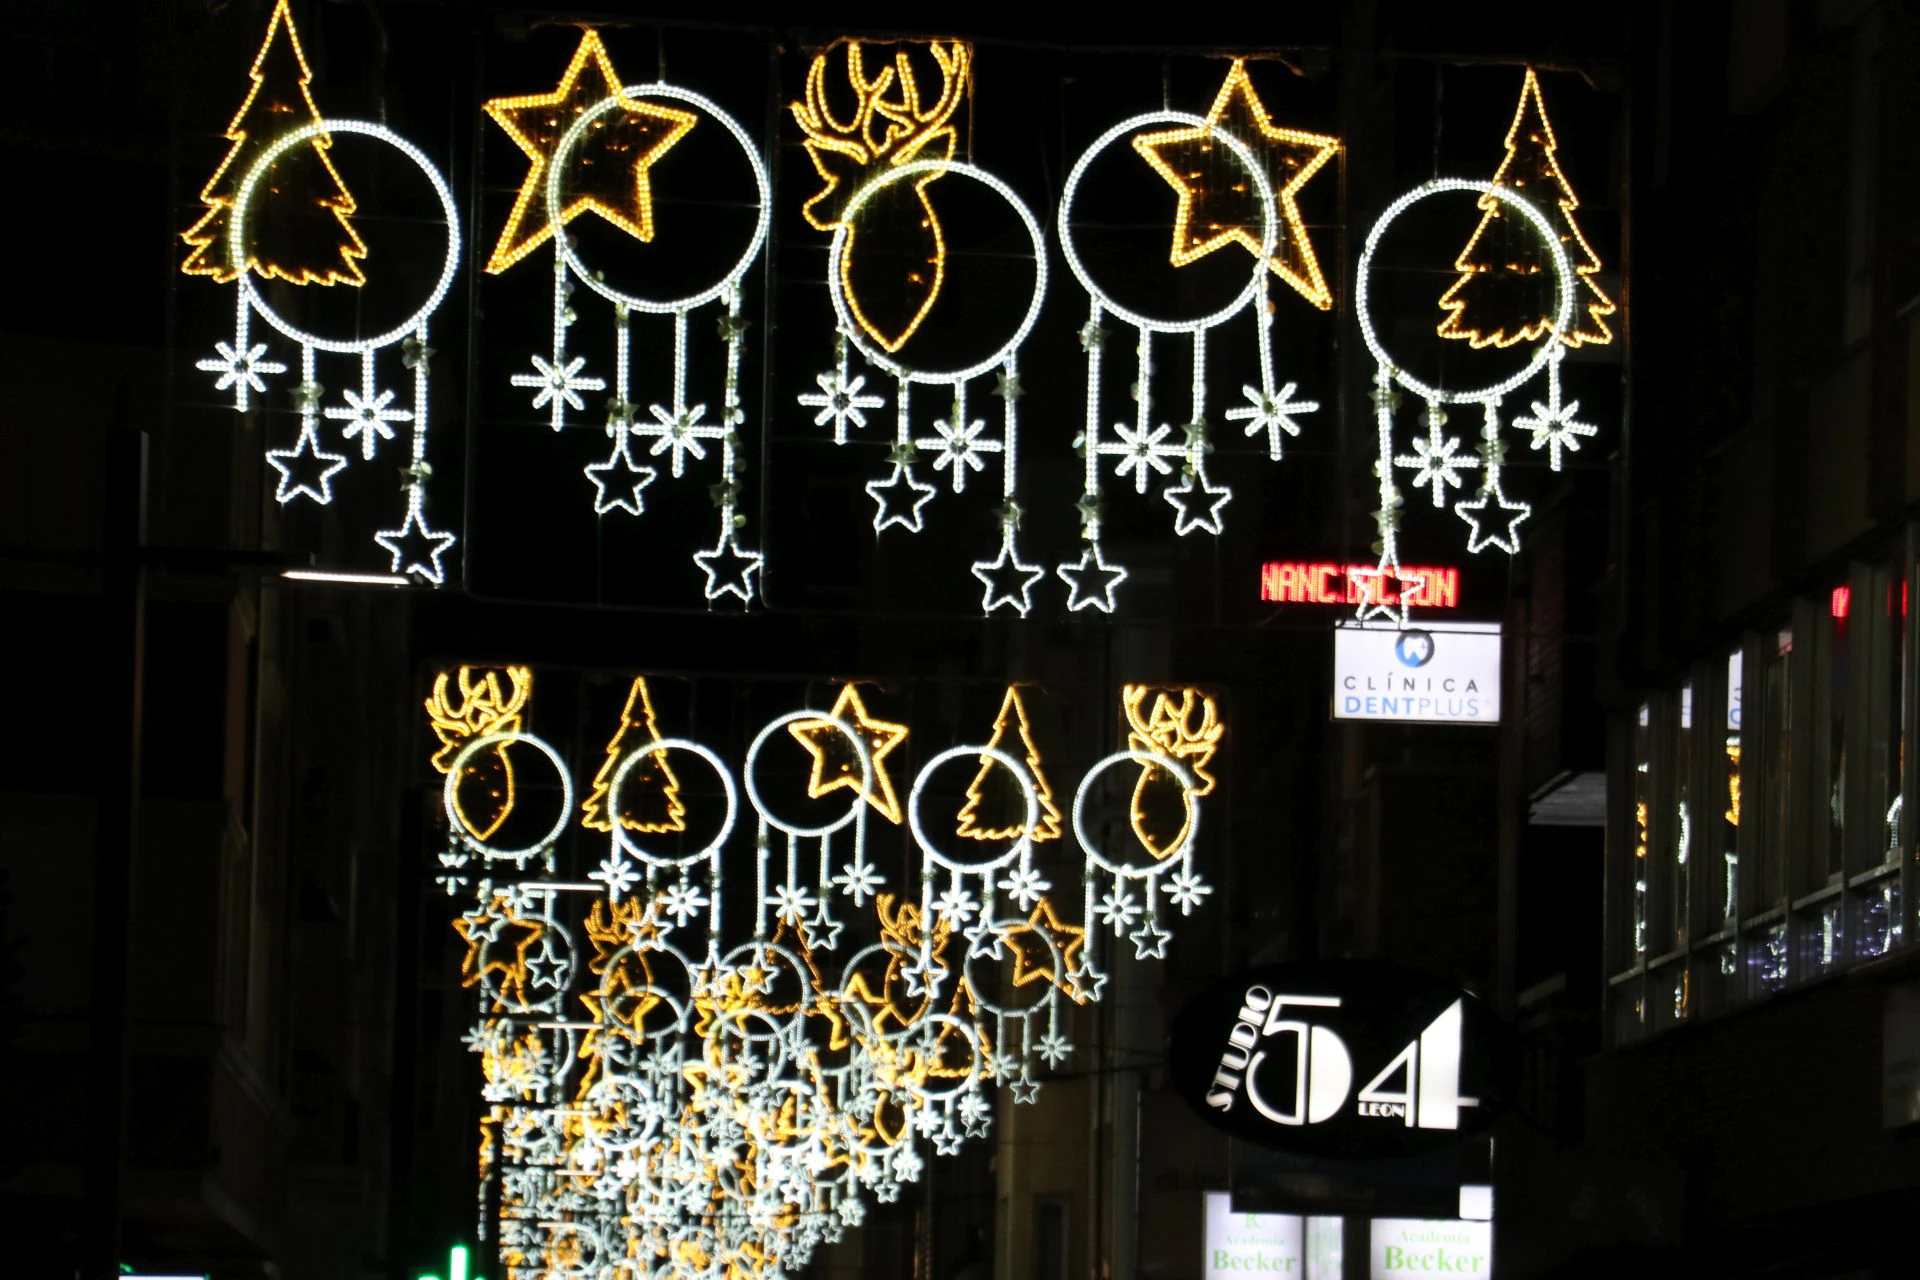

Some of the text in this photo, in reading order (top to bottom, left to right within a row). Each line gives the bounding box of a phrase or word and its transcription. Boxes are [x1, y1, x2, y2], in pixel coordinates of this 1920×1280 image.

[1344, 672, 1479, 693] CLÍNICA
[1344, 695, 1479, 717] DENTPLUS
[1206, 984, 1272, 1113] STUDIO
[1245, 994, 1480, 1130] 54
[1358, 1102, 1405, 1118] LEON
[1399, 1229, 1471, 1244] Academia
[1212, 1248, 1297, 1273] Becker
[1383, 1245, 1485, 1274] Becker
